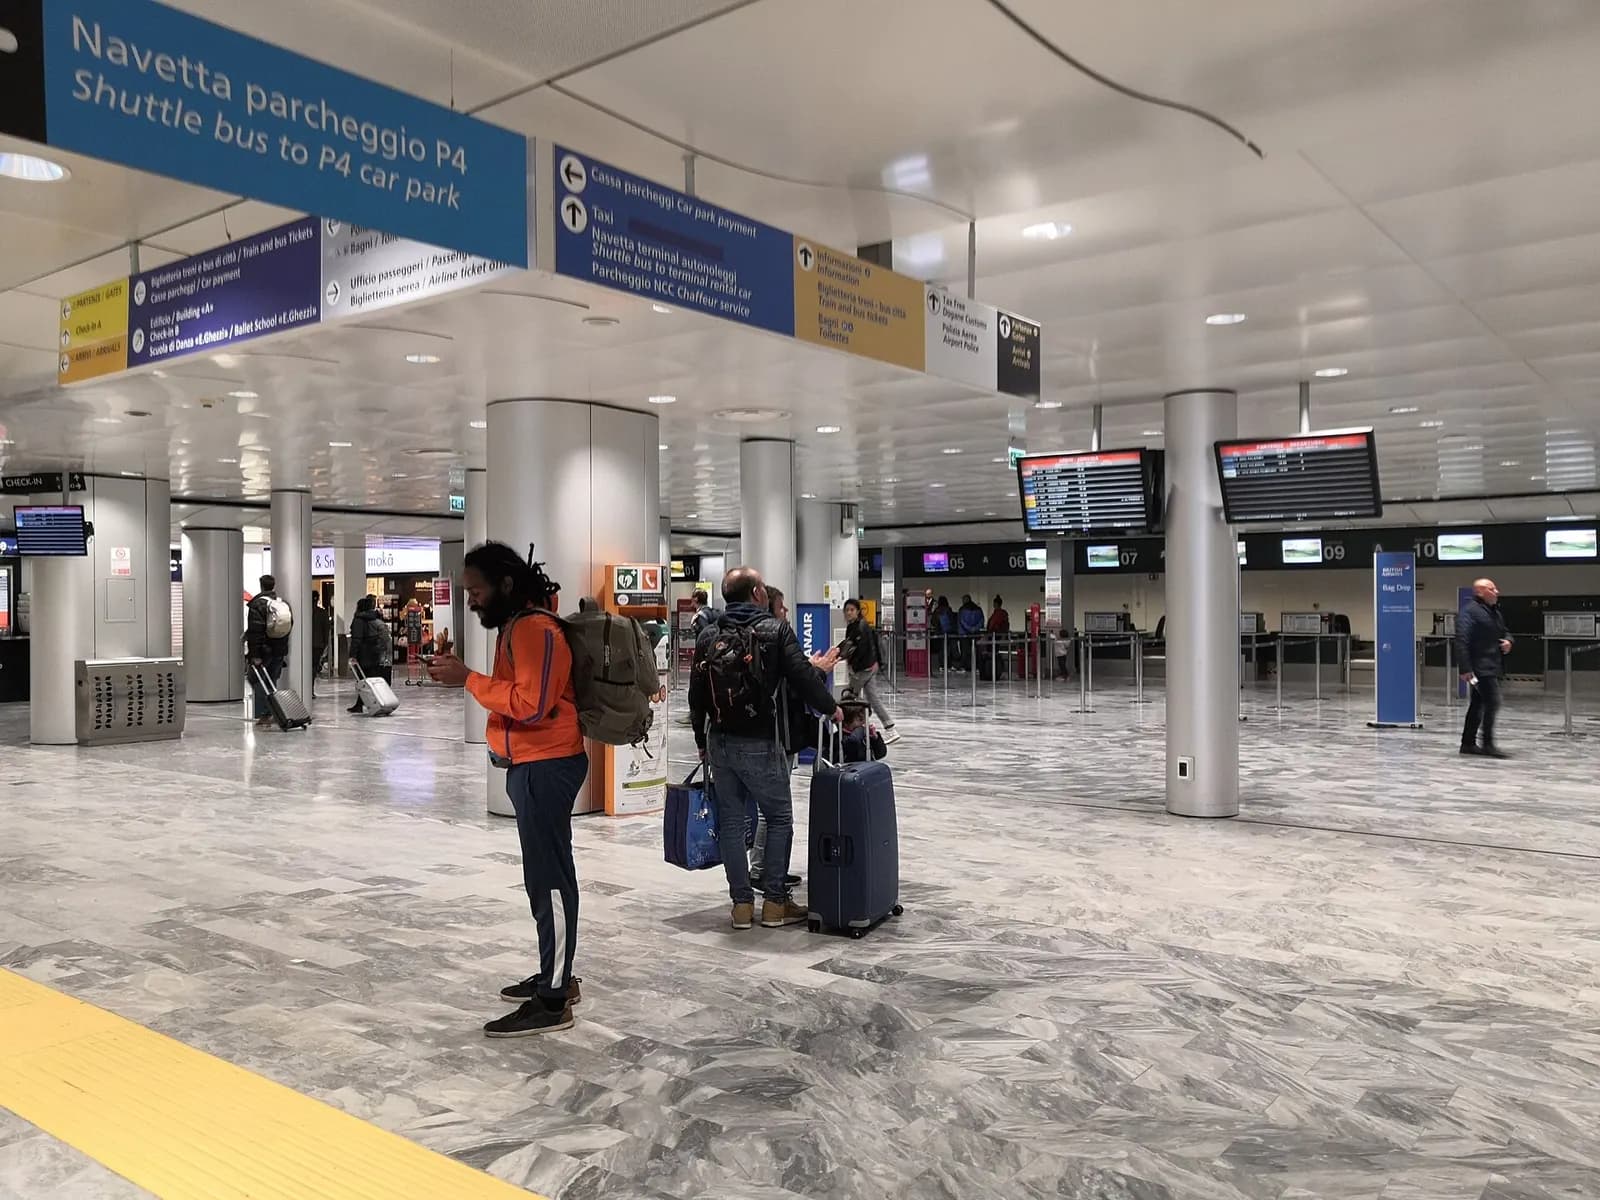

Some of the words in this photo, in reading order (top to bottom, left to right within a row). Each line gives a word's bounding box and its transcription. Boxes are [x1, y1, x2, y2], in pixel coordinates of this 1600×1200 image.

[72, 14, 231, 100] Navetta
[246, 81, 426, 161] parcheggio
[436, 138, 467, 175] P4
[72, 69, 202, 135] Shuttle
[214, 112, 267, 154] bus
[278, 135, 309, 165] to
[319, 144, 351, 178] P4
[360, 163, 399, 191] car
[405, 176, 460, 210] park
[591, 165, 621, 190] Cassa
[624, 180, 674, 211] parcheggi
[677, 197, 693, 215] Car
[694, 206, 716, 224] park
[717, 215, 756, 238] payment
[592, 205, 614, 225] Taxi
[202, 258, 214, 272] bus
[215, 254, 222, 268] di
[243, 242, 260, 259] Train
[260, 236, 274, 254] and
[274, 234, 288, 250] bus
[288, 226, 314, 246] Tickets
[350, 236, 373, 256] Bagni
[592, 225, 635, 252] Navetta
[638, 240, 679, 265] terminal
[682, 255, 737, 285] autonoleggi
[212, 266, 241, 288] payment
[350, 273, 377, 290] Ufficio
[378, 257, 423, 284] passeggeri
[592, 242, 632, 265] Shuttle
[634, 252, 652, 271] bus
[655, 260, 666, 275] to
[669, 264, 708, 288] terminal
[710, 279, 737, 296] rental
[739, 287, 752, 301] car
[350, 287, 394, 307] Biglietteria
[396, 281, 420, 294] aerea
[428, 270, 458, 287] Airline
[461, 261, 486, 279] ticket
[592, 260, 651, 290] Parcheggio
[654, 277, 674, 297] NCC
[720, 300, 750, 318] service
[837, 302, 852, 315] and
[149, 341, 168, 357] Scuola
[168, 339, 175, 353] di
[175, 336, 194, 351] Danza
[234, 319, 254, 337] Ballet
[254, 312, 278, 331] School
[5, 477, 43, 488] CHECK-IN
[315, 554, 321, 568] &
[325, 554, 335, 568] Sn
[1120, 552, 1138, 565] 07
[1323, 545, 1345, 560] 09
[1413, 542, 1435, 558] 10
[685, 565, 695, 577] 01
[950, 557, 965, 569] 05
[1008, 556, 1025, 569] 06
[803, 612, 813, 658] ANAIR
